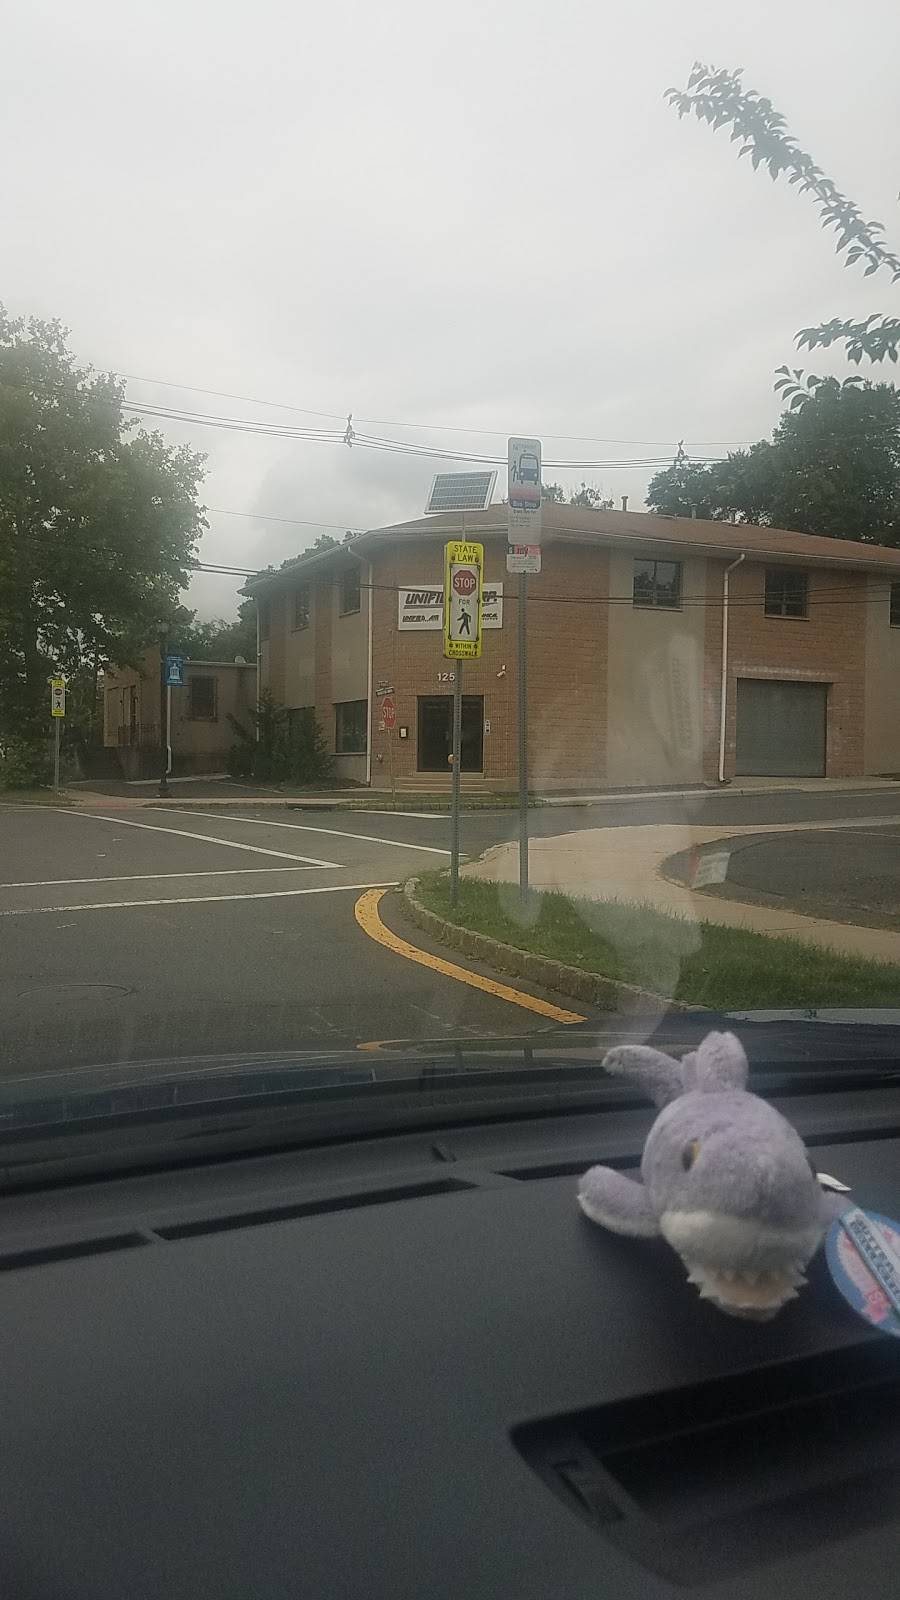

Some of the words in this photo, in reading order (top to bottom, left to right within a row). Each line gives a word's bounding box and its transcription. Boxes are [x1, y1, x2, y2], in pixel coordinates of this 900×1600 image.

[454, 545, 477, 554] STATE
[457, 554, 473, 562] LAW
[454, 578, 475, 588] STOP
[437, 672, 455, 681] 125
